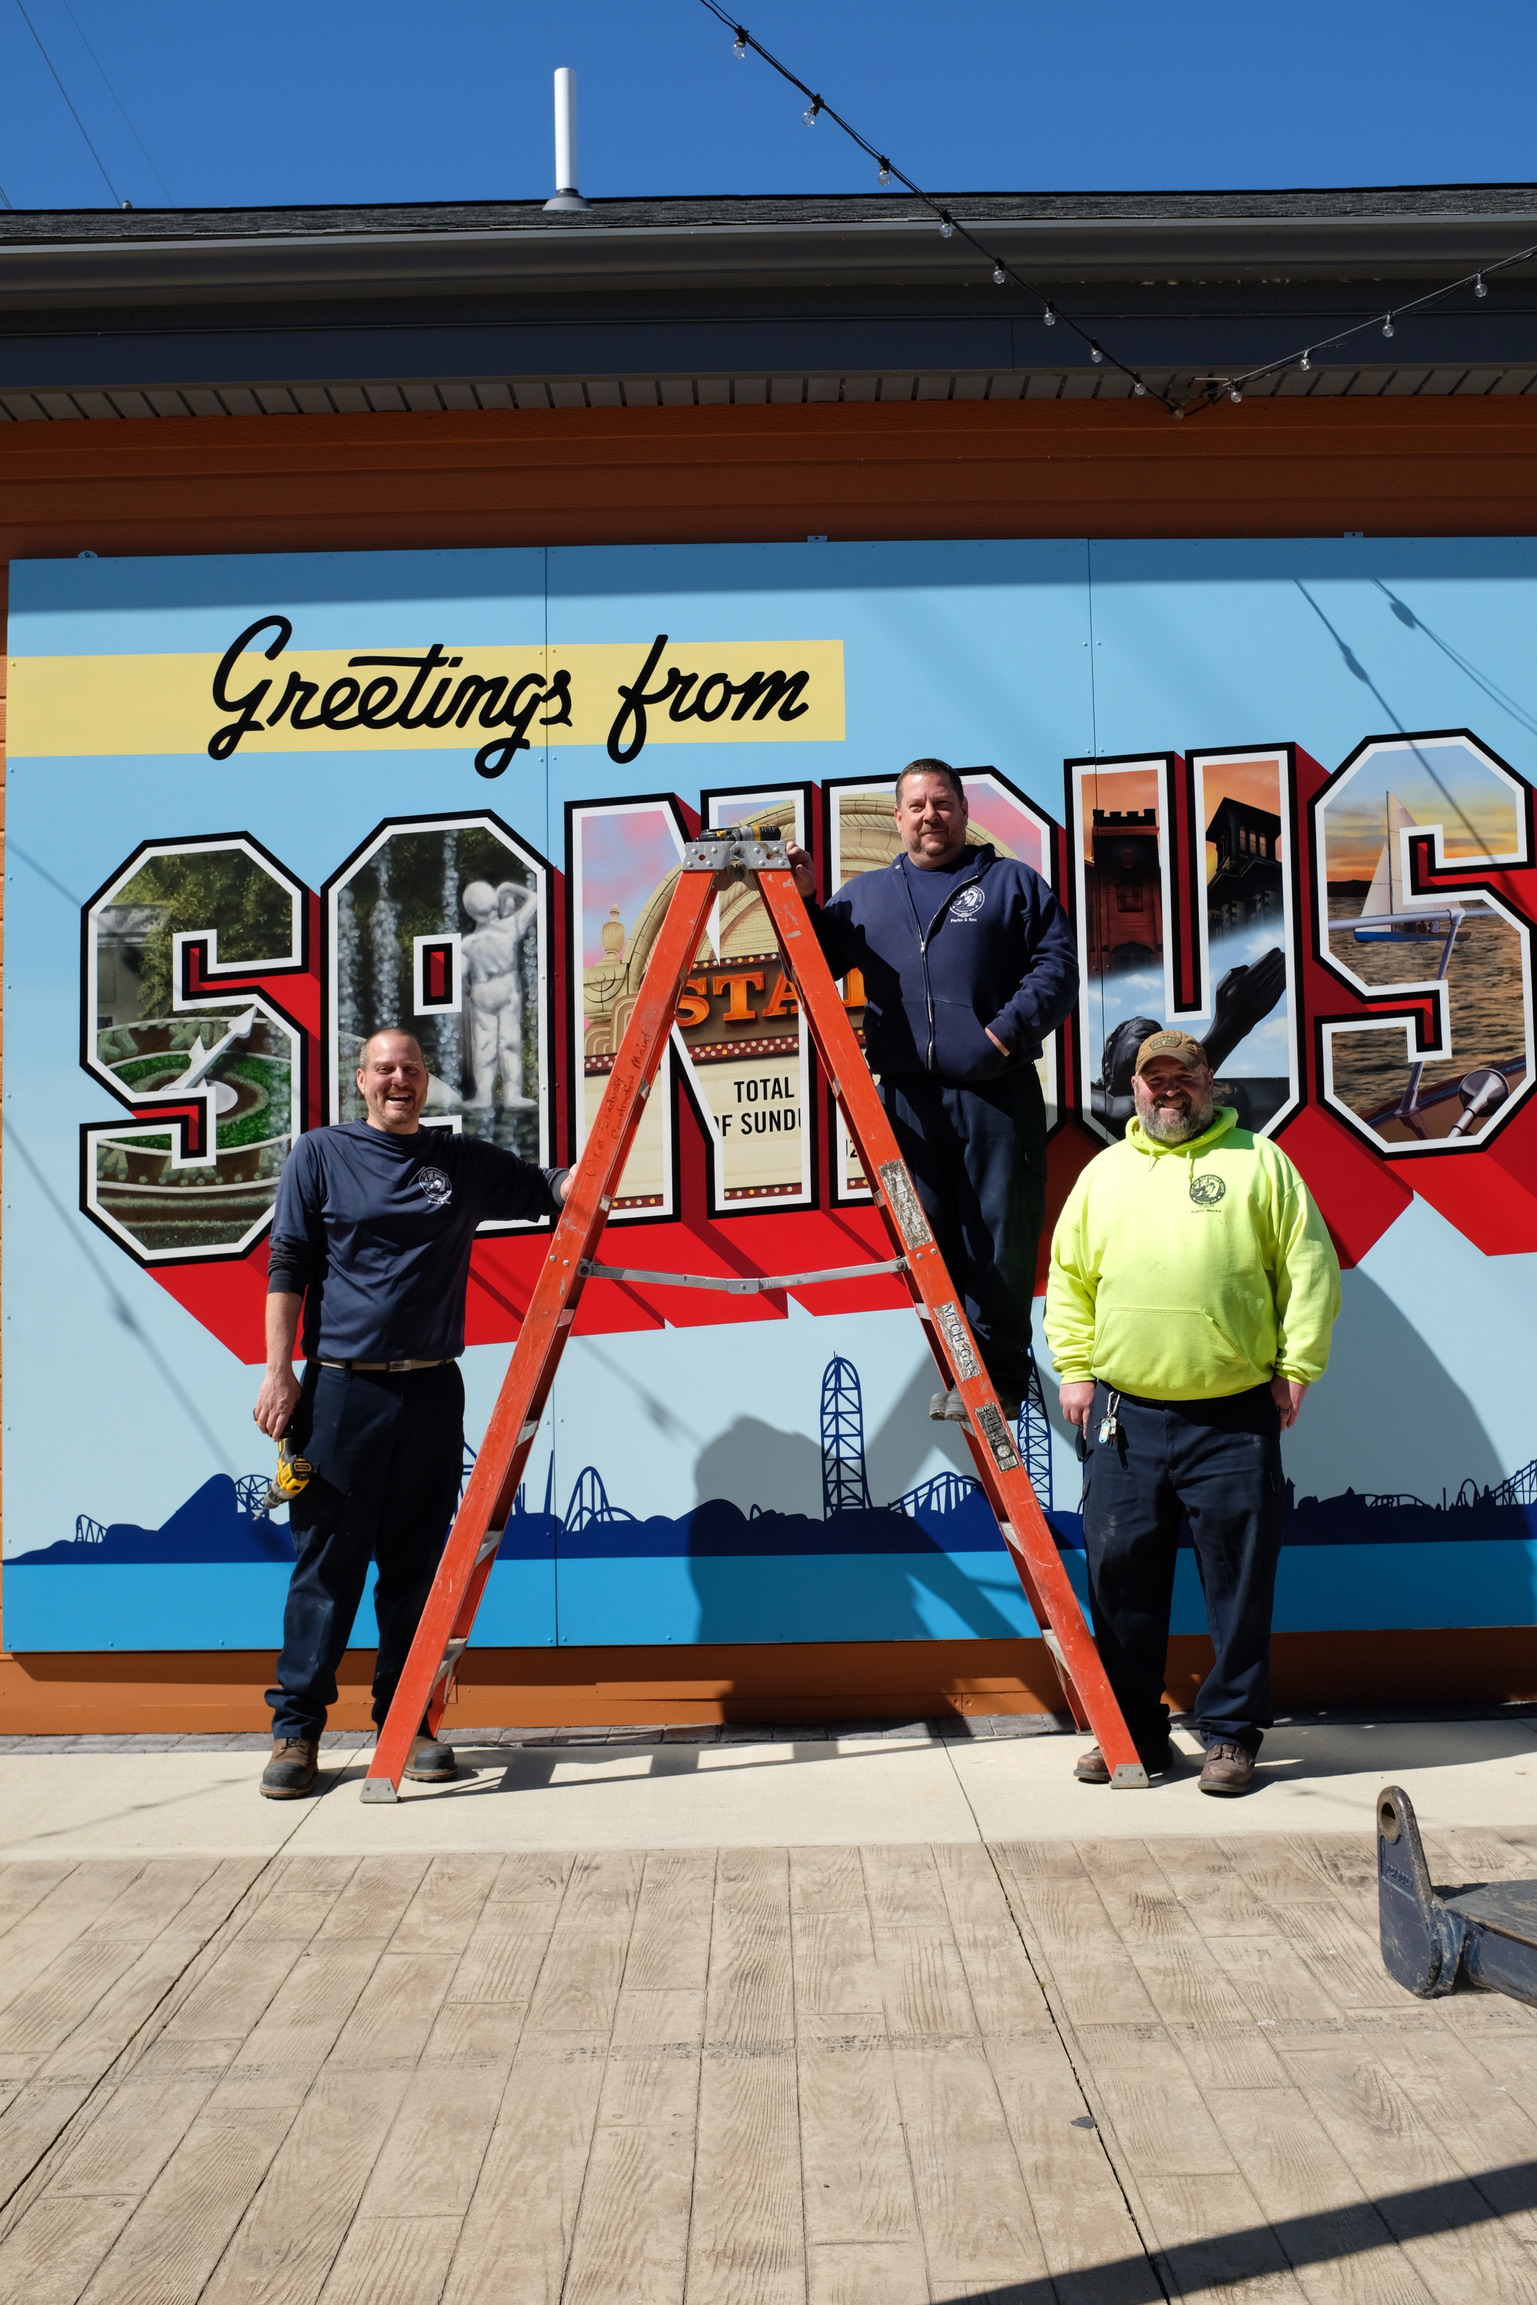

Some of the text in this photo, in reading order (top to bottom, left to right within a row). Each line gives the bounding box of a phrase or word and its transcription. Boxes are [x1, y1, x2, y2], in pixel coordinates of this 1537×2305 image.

[208, 614, 810, 779] Greetings from
[733, 1077, 795, 1103] TOTAL
